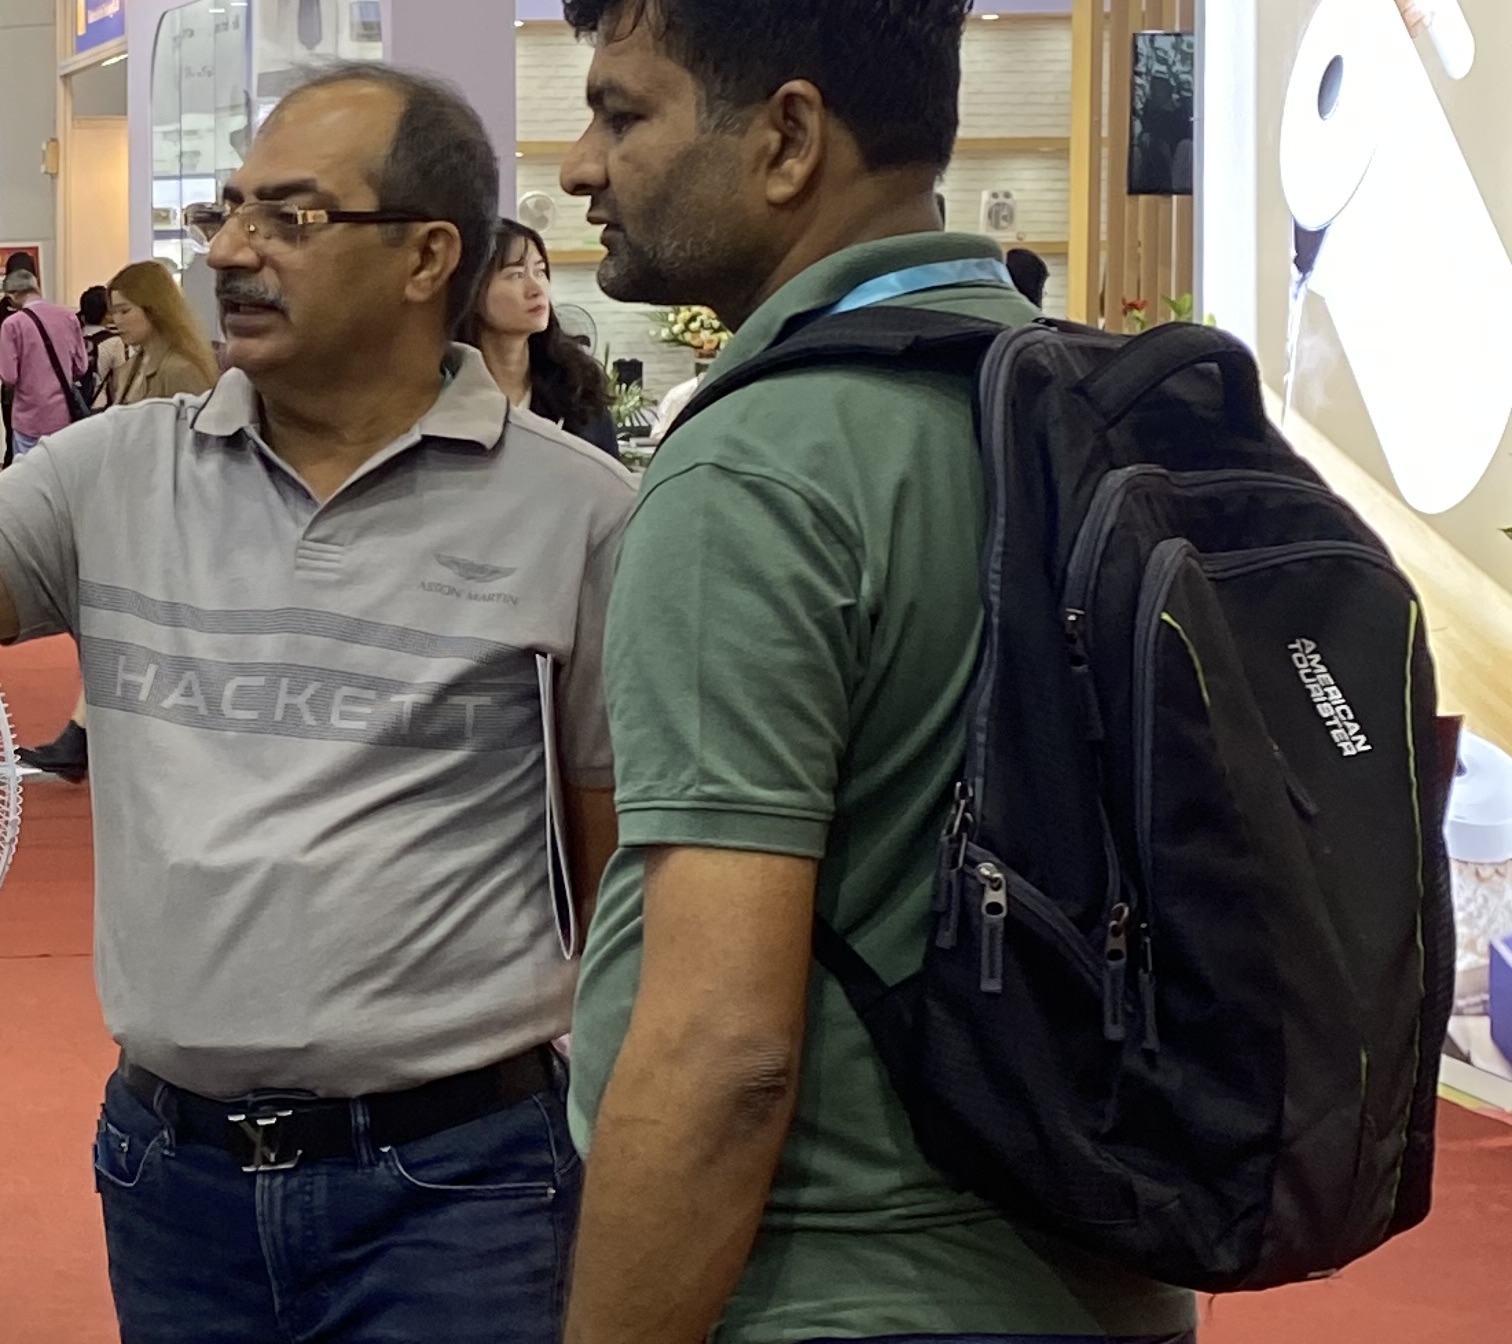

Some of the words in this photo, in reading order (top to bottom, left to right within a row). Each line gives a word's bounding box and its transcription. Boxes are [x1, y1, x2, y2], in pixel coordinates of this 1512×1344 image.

[115, 655, 493, 739] HACKETT
[1288, 639, 1358, 756] TOURISTER
[1300, 638, 1372, 752] AMERICAN
